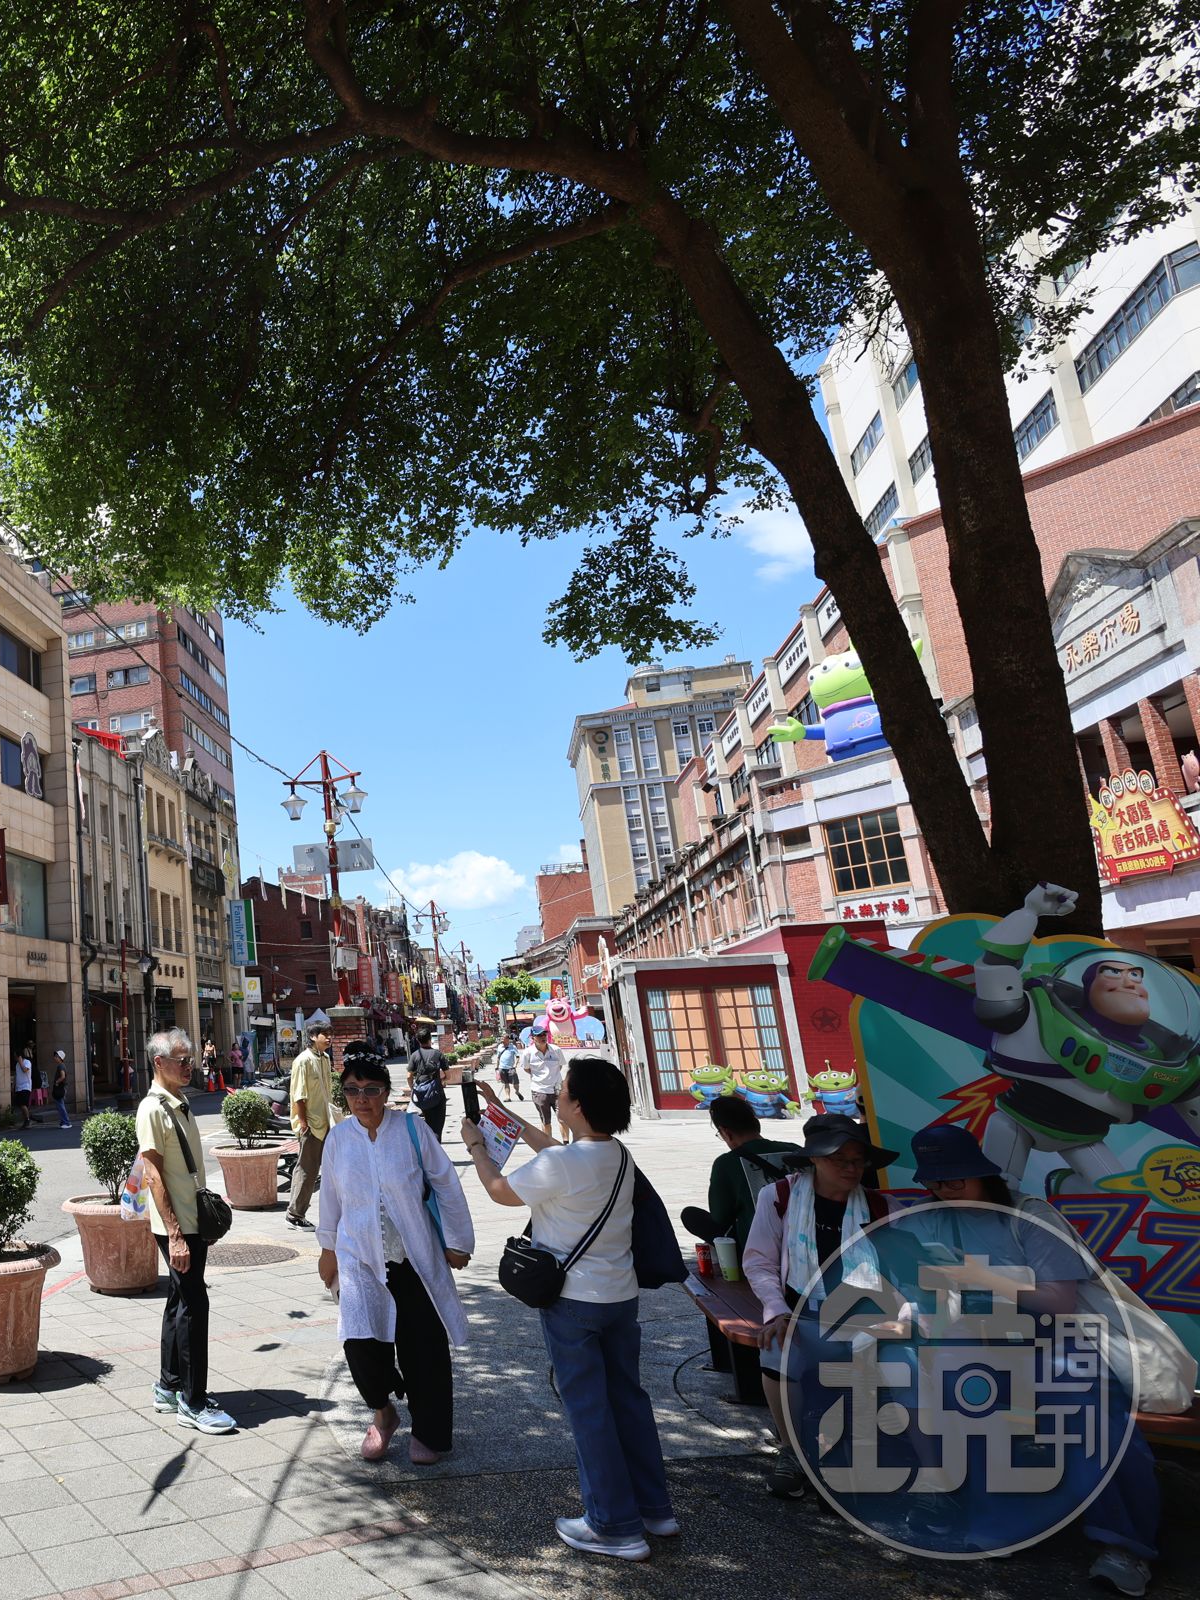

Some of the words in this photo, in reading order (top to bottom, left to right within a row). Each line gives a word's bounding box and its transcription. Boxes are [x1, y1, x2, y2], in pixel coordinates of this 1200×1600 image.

[1065, 602, 1141, 674] 永樂市場
[1115, 799, 1152, 830] 大稻埕
[1112, 819, 1171, 856] 復古玩具店
[843, 898, 910, 919] 永樂市場
[233, 905, 246, 957] FamilyMart
